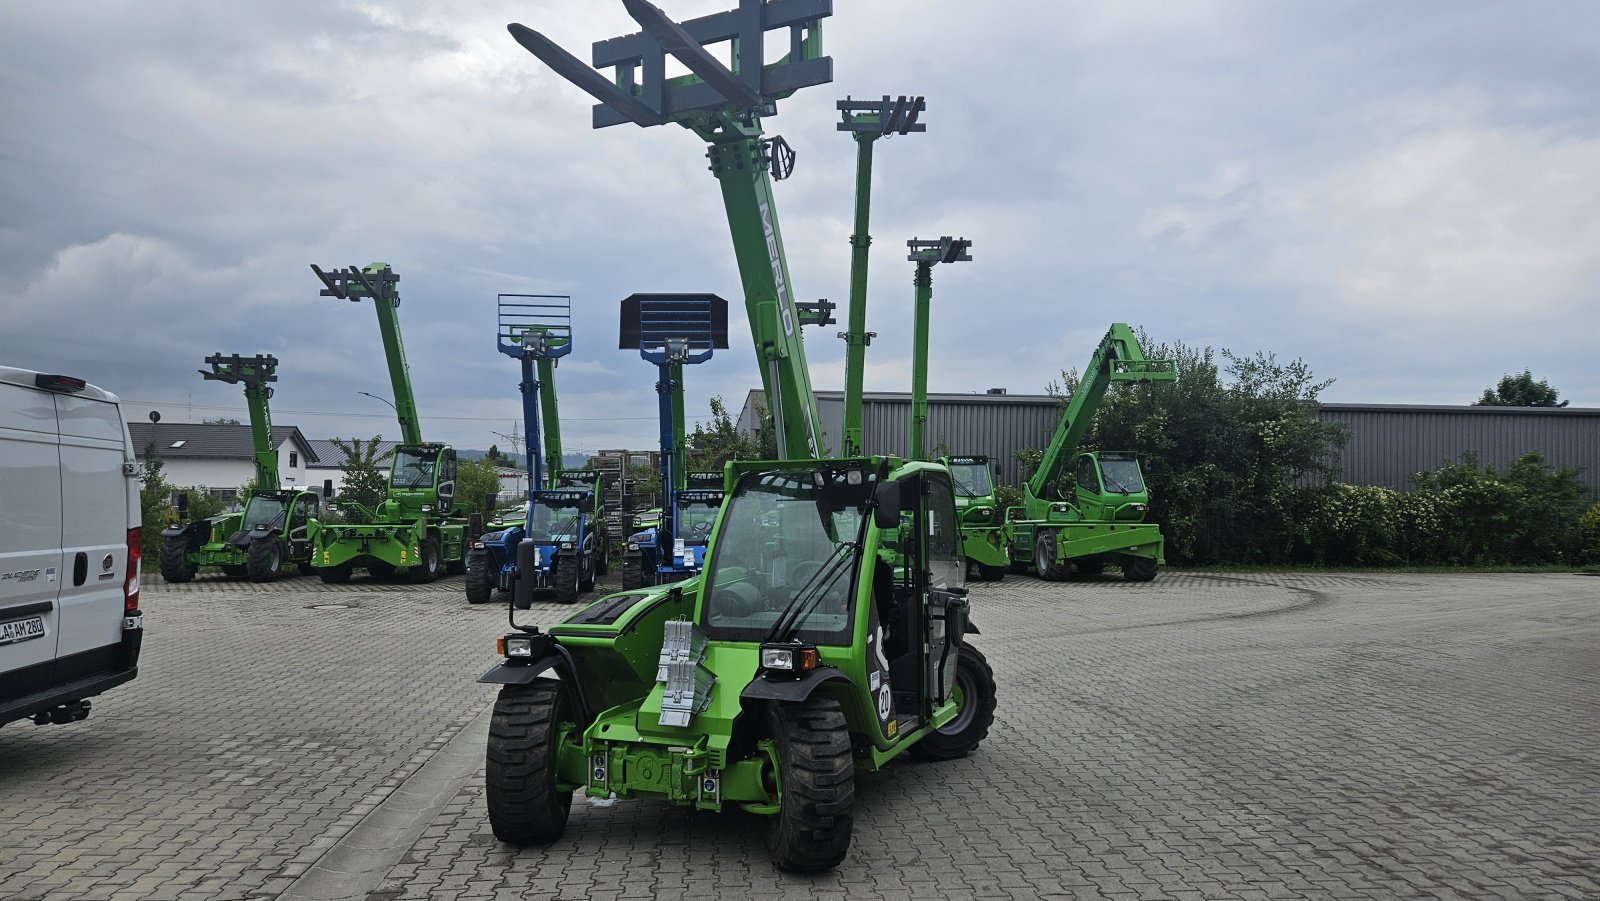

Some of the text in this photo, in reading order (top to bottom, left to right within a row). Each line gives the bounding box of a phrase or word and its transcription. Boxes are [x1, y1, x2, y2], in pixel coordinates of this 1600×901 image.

[760, 202, 793, 336] MERLO
[263, 405, 272, 451] MERLO
[15, 623, 27, 637] AM
[27, 620, 43, 635] 280
[881, 690, 889, 714] 20
